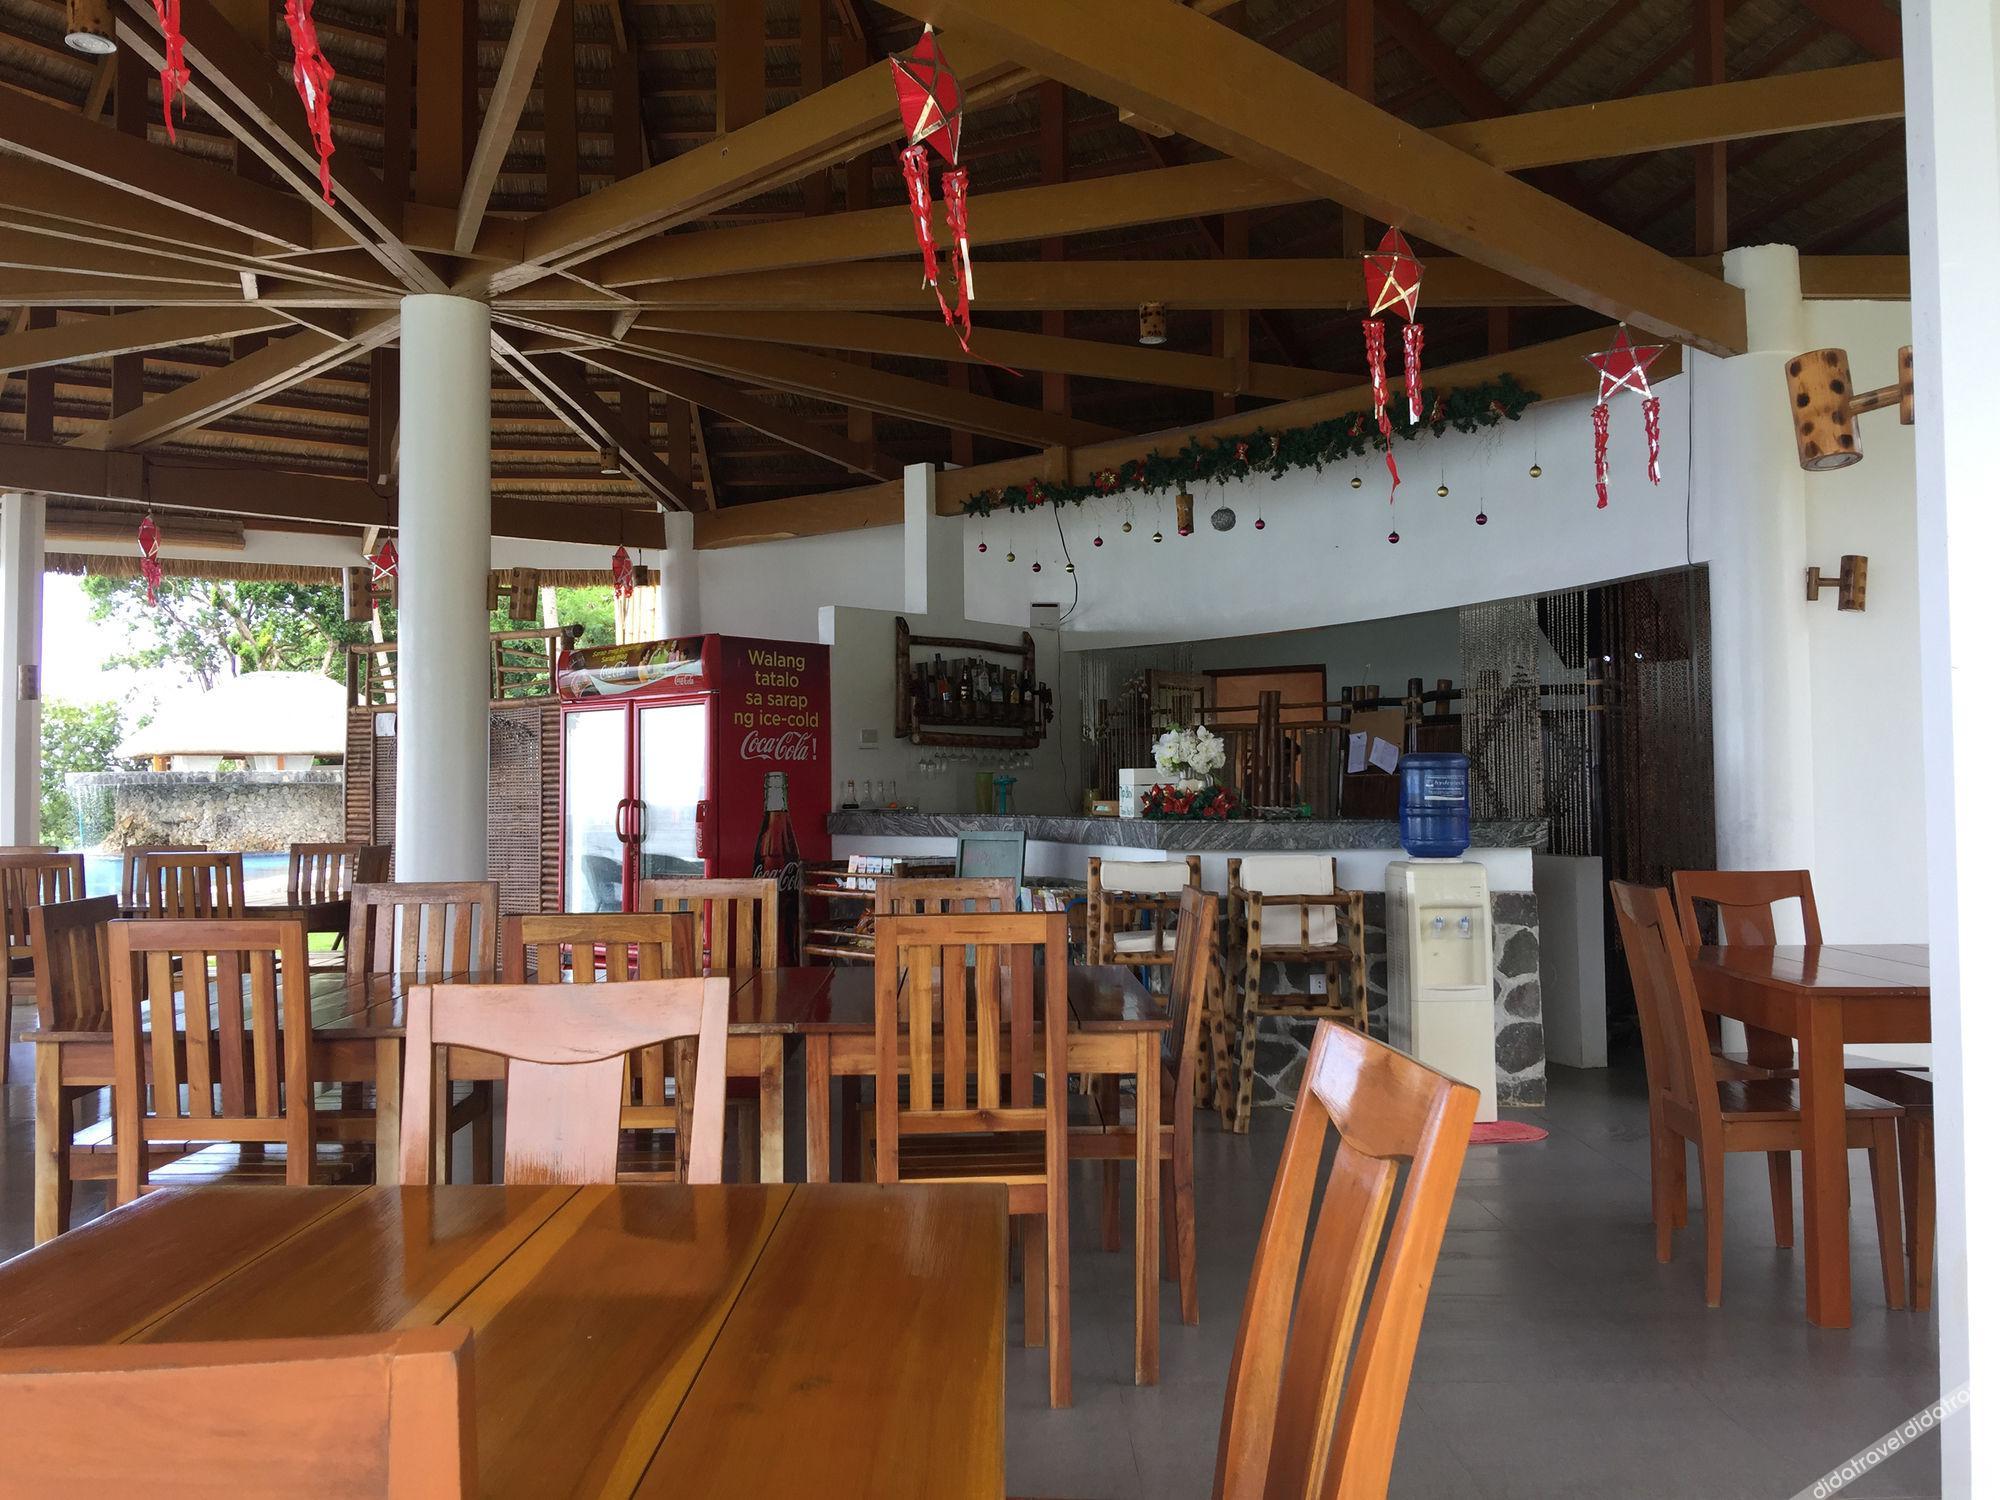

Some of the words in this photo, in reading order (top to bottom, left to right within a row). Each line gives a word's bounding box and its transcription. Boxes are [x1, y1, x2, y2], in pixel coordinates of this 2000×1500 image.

[748, 649, 805, 671] Walang
[754, 670, 799, 688] tatalo
[745, 692, 763, 706] sa
[767, 693, 808, 711] sarap
[734, 711, 754, 728] ng
[759, 709, 819, 728] ice-cold
